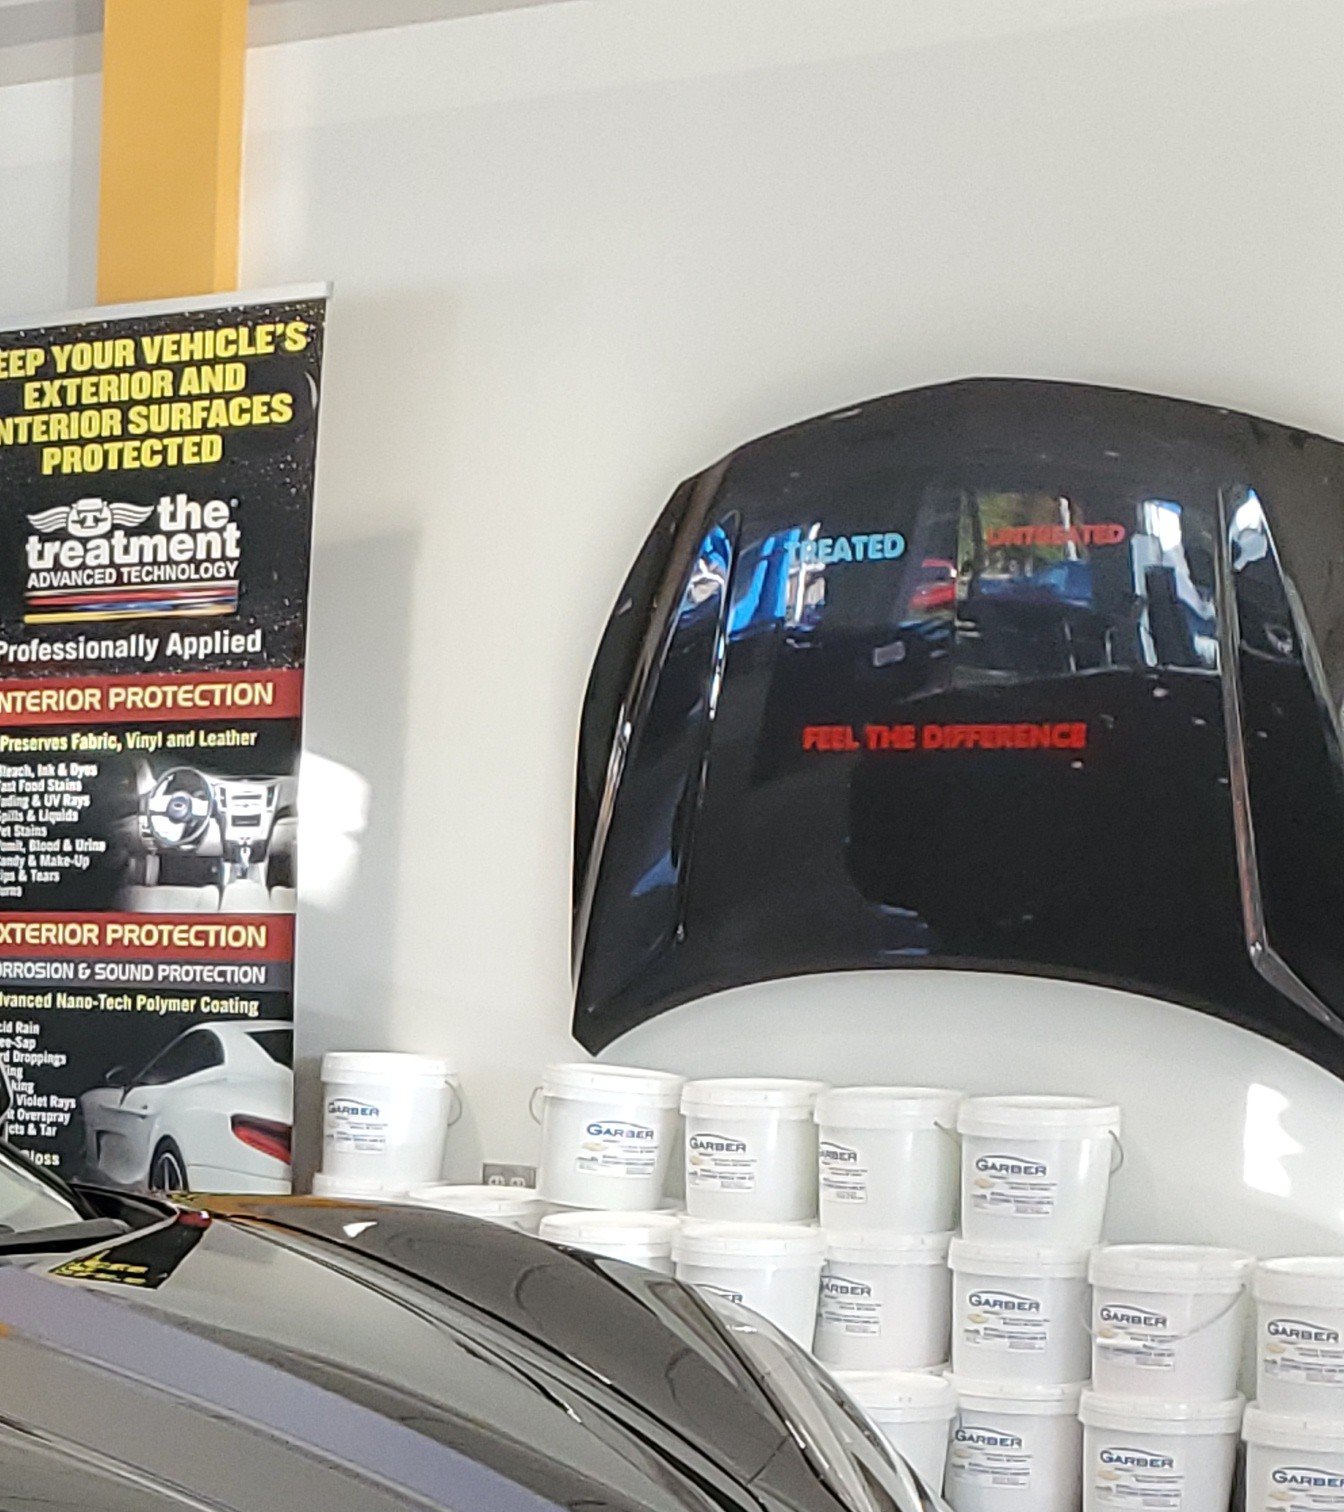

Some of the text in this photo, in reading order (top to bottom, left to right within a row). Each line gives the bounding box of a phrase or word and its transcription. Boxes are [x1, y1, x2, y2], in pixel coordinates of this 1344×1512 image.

[53, 337, 136, 373] YOUR
[141, 321, 310, 366] VEHICLE'S
[23, 363, 247, 410] EXTERIOR AND
[127, 393, 294, 435] SURFACES
[42, 434, 223, 475] PROTECTED
[157, 494, 230, 530] the
[985, 523, 1127, 547] UNTREATED
[25, 522, 242, 570] treatment
[785, 532, 906, 564] TREATED
[27, 560, 240, 589] ADVANCED TECHNOLOGY
[165, 629, 263, 661] Applied
[109, 682, 274, 710] PROTECTION
[0, 729, 258, 753] Preserves Fabric, Vinyl and Leather
[802, 722, 1088, 751] FEEL THE DIFFERENCE
[58, 763, 68, 777] &
[18, 779, 45, 792] Food
[31, 794, 41, 807] &
[44, 794, 60, 807] UV
[62, 794, 91, 809] Rays
[26, 809, 36, 822] &
[14, 824, 48, 837] Stains
[63, 839, 73, 852] &
[28, 854, 37, 867] &
[18, 869, 28, 882] &
[105, 924, 267, 948] PROTECTION
[78, 961, 91, 980] &
[94, 962, 155, 982] SOUND
[157, 965, 266, 985] PROTECTION
[56, 993, 132, 1012] Nano-Tech
[136, 994, 197, 1015] Polymer
[200, 997, 260, 1017] Coating
[15, 1020, 40, 1035] Rain
[13, 1050, 68, 1068] Droppings
[15, 1094, 77, 1111] Violet Rays
[326, 1101, 381, 1118] GARBER
[17, 1108, 72, 1126] Overspray
[26, 1123, 38, 1137] &
[39, 1124, 58, 1137] Tar
[586, 1122, 655, 1141] GARBER
[688, 1136, 748, 1154] GARBER
[819, 1149, 858, 1163] ARBER
[975, 1158, 1048, 1177] GARBER
[968, 1291, 1042, 1313] GARBER
[1098, 1306, 1168, 1328] GARBER
[1267, 1320, 1340, 1344] GARBER
[954, 1428, 1024, 1449] GARBER
[1098, 1449, 1175, 1470] GARBER
